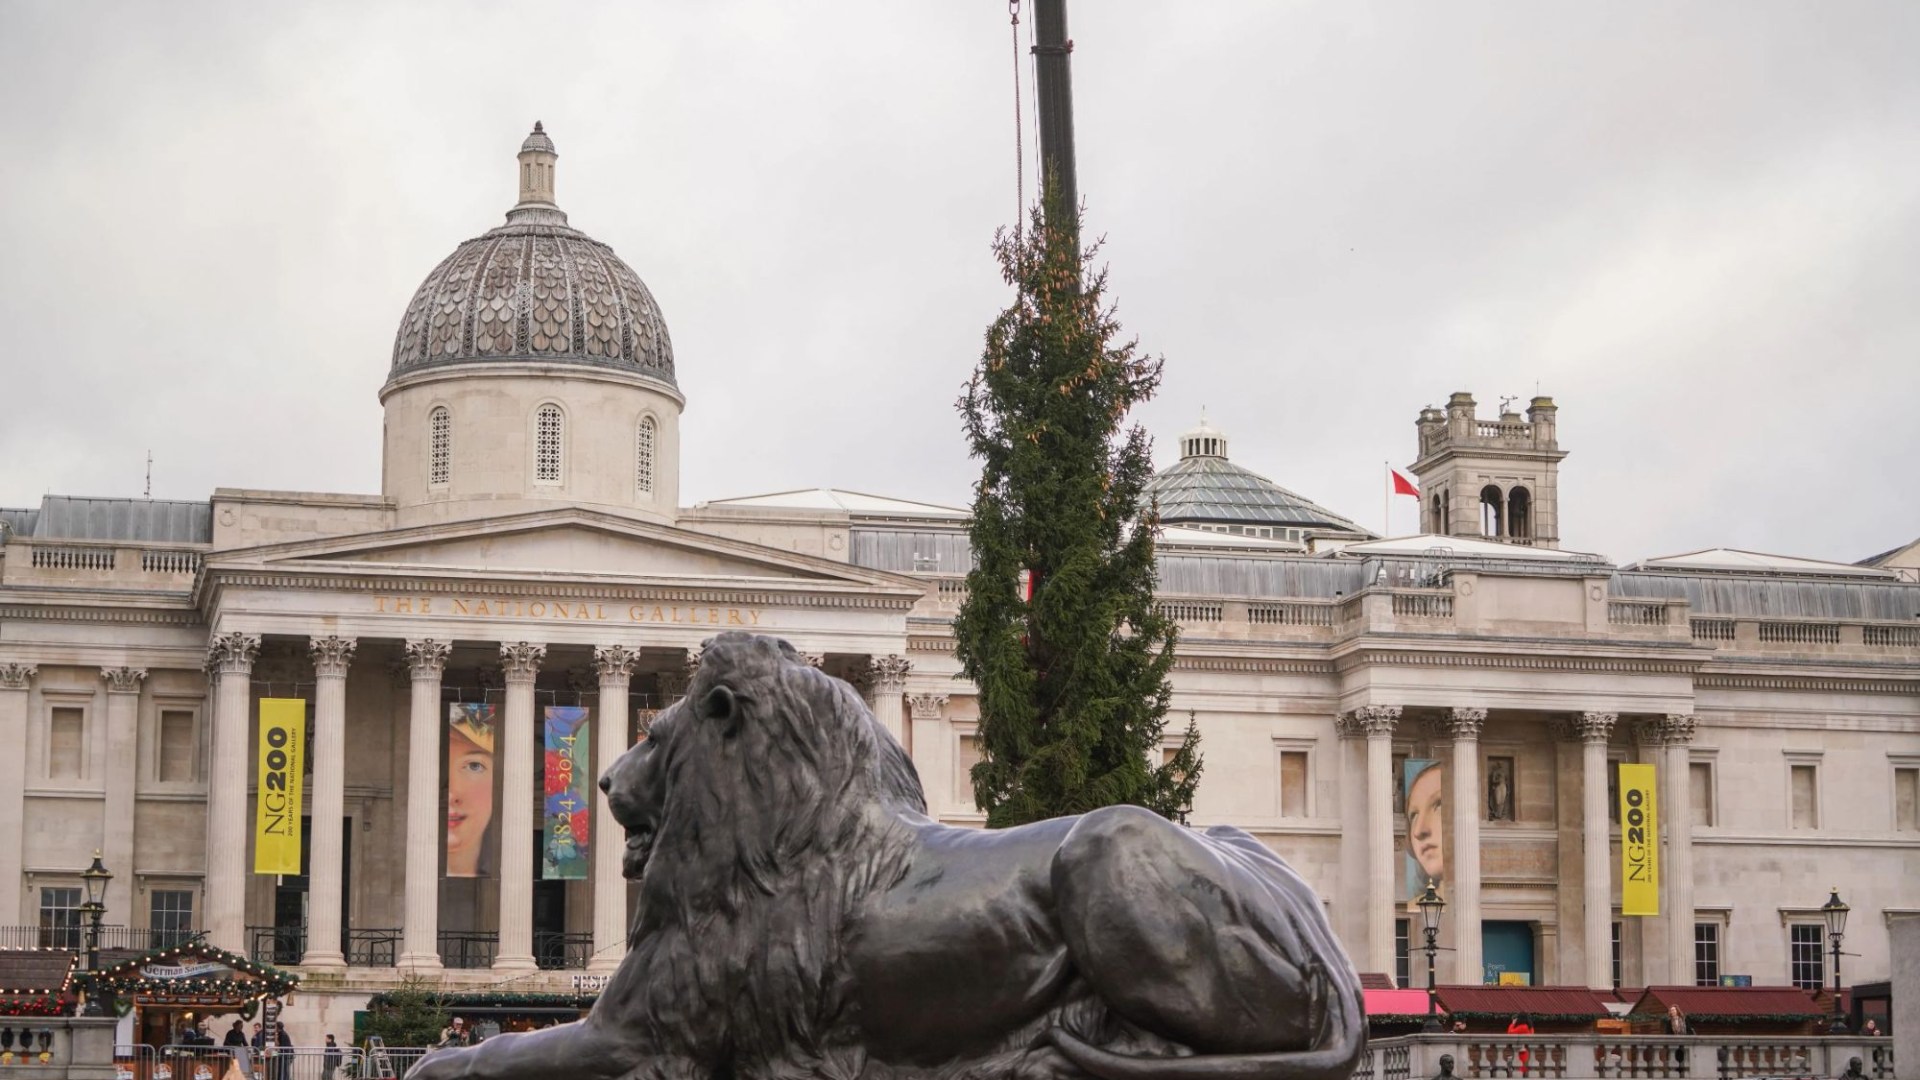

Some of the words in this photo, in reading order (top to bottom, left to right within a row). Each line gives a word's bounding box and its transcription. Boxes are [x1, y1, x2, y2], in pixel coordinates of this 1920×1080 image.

[374, 596, 432, 614] THE
[452, 599, 608, 620] NATIONAL
[629, 605, 763, 625] GALLERY
[265, 727, 287, 835] NG200
[288, 797, 294, 806] OF
[1626, 789, 1645, 882] NG200
[144, 963, 183, 976] German
